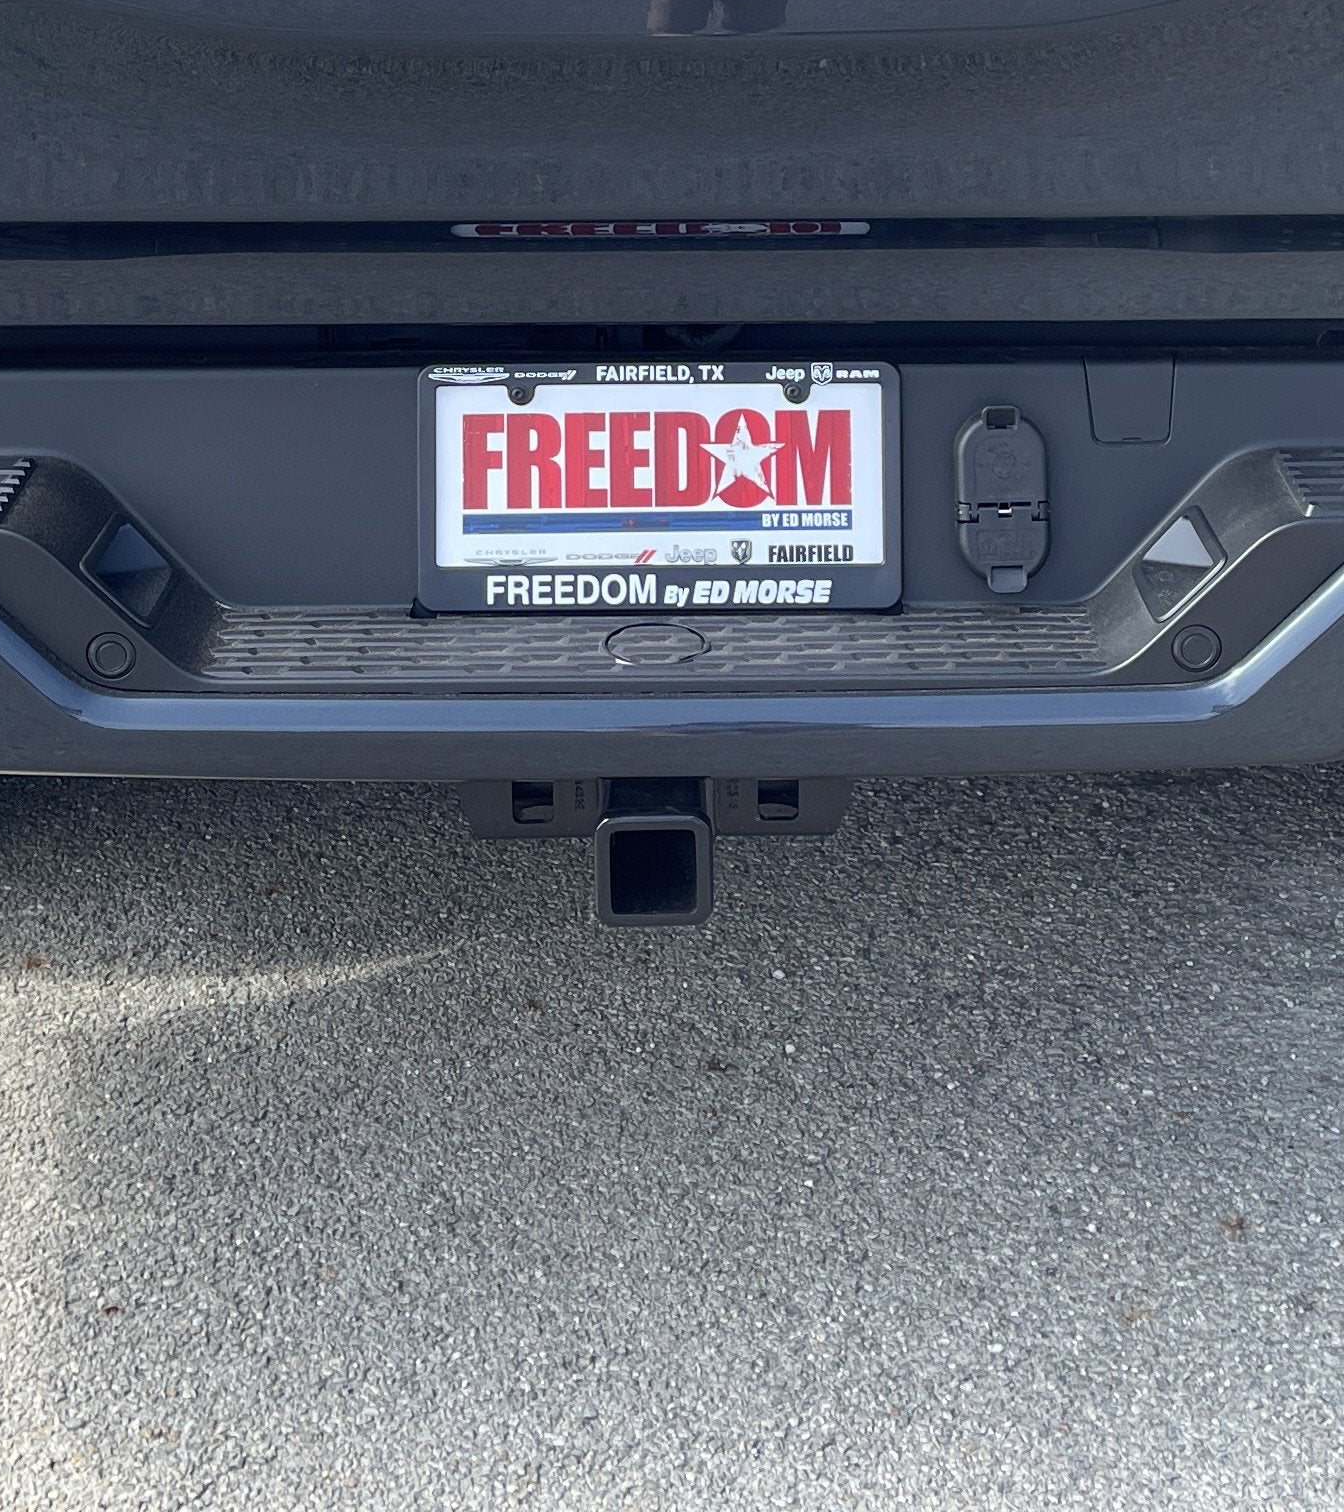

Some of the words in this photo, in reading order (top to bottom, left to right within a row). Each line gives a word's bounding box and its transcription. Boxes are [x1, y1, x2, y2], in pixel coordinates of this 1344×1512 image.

[596, 364, 695, 384] FAIRFIELD,
[698, 365, 725, 381] TX
[765, 366, 806, 382] Jeep
[835, 369, 881, 379] RAM
[462, 409, 852, 510] FREEDOM
[761, 513, 778, 528] BY
[782, 513, 799, 527] ED
[801, 512, 849, 527] MORSE
[664, 544, 718, 566] Jeep
[768, 544, 855, 563] FAIRFIELD
[486, 573, 657, 606] FREEDOM
[663, 585, 690, 608] By
[692, 580, 732, 605] ED
[732, 579, 833, 605] MORSE
